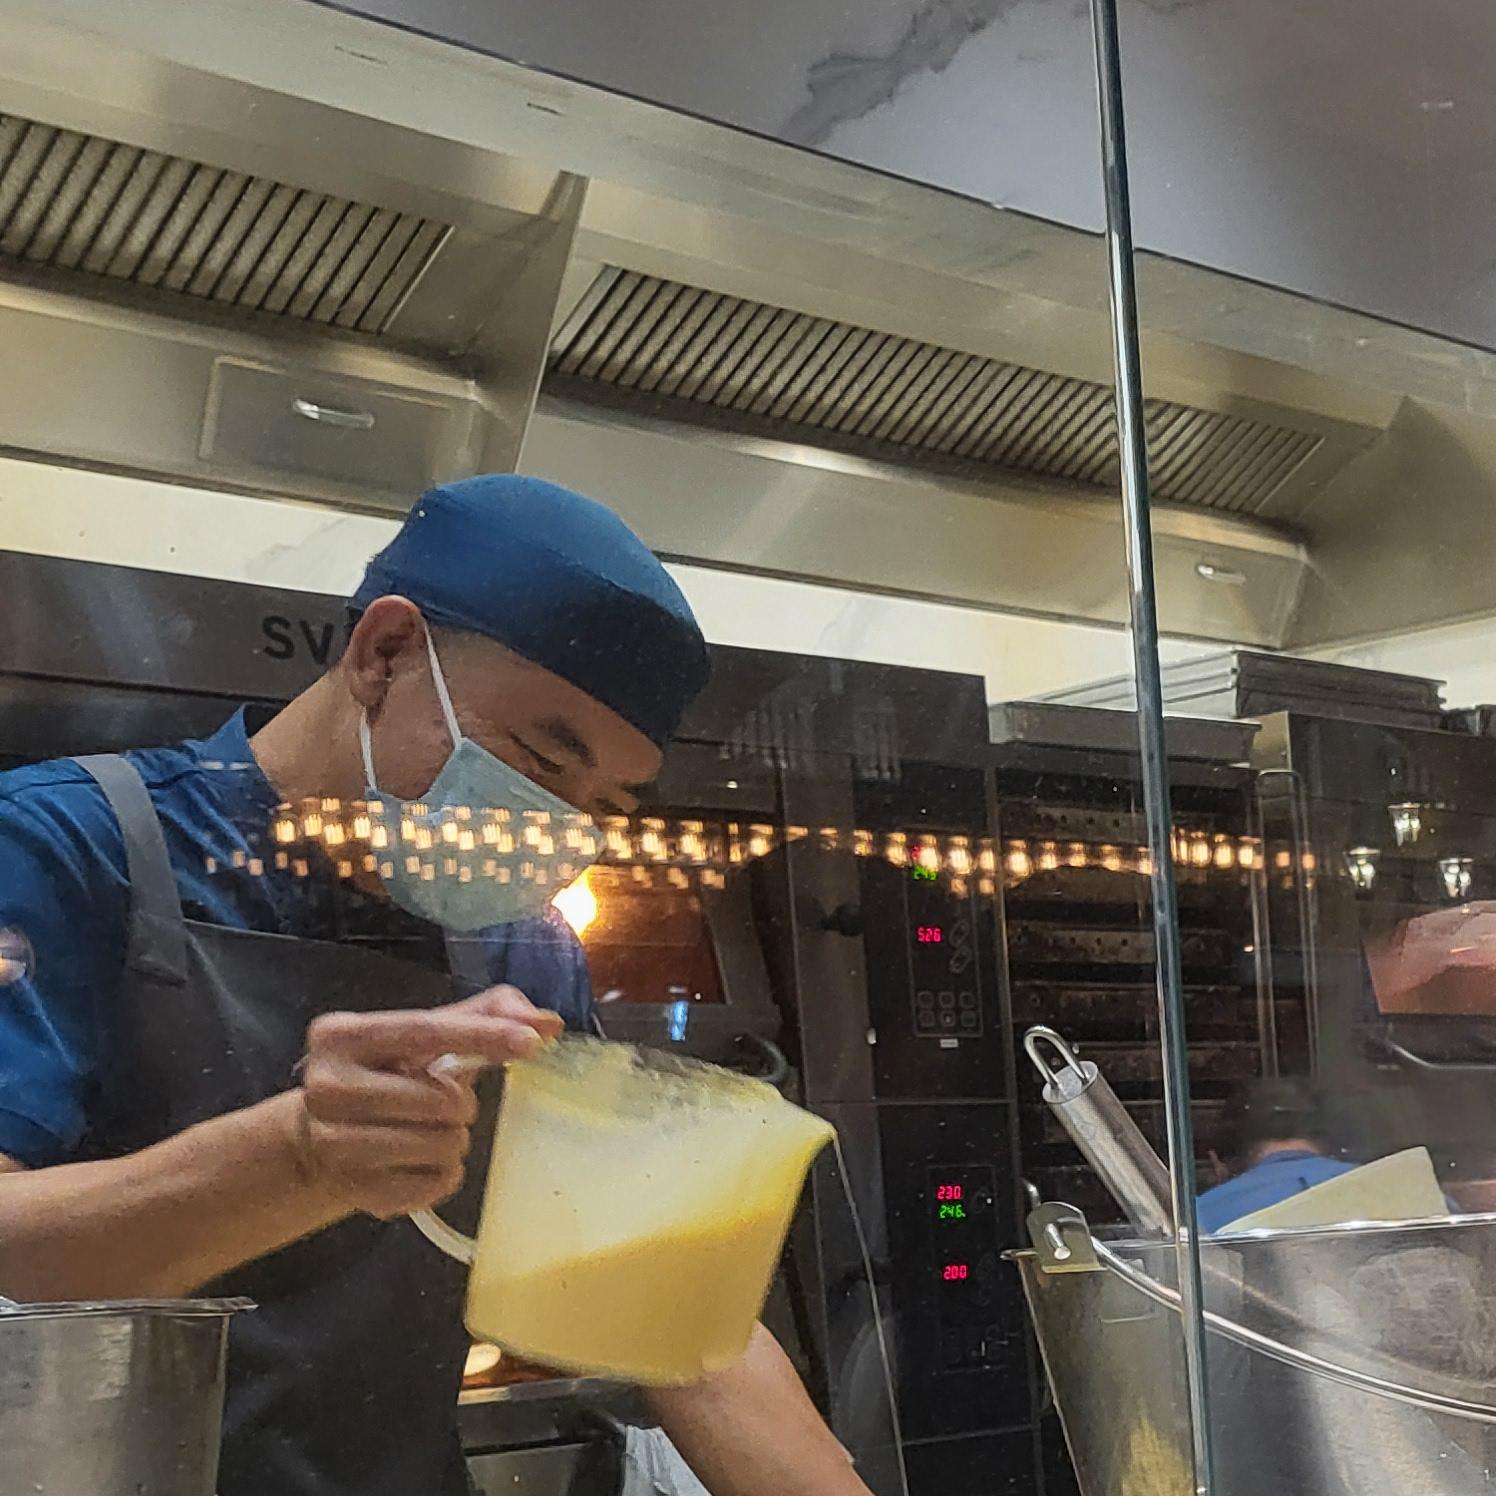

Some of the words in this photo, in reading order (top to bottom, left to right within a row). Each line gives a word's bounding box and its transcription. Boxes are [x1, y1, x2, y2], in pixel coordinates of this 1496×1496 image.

[262, 615, 350, 665] SV
[937, 1185, 961, 1200] 230
[943, 1265, 967, 1280] 200
